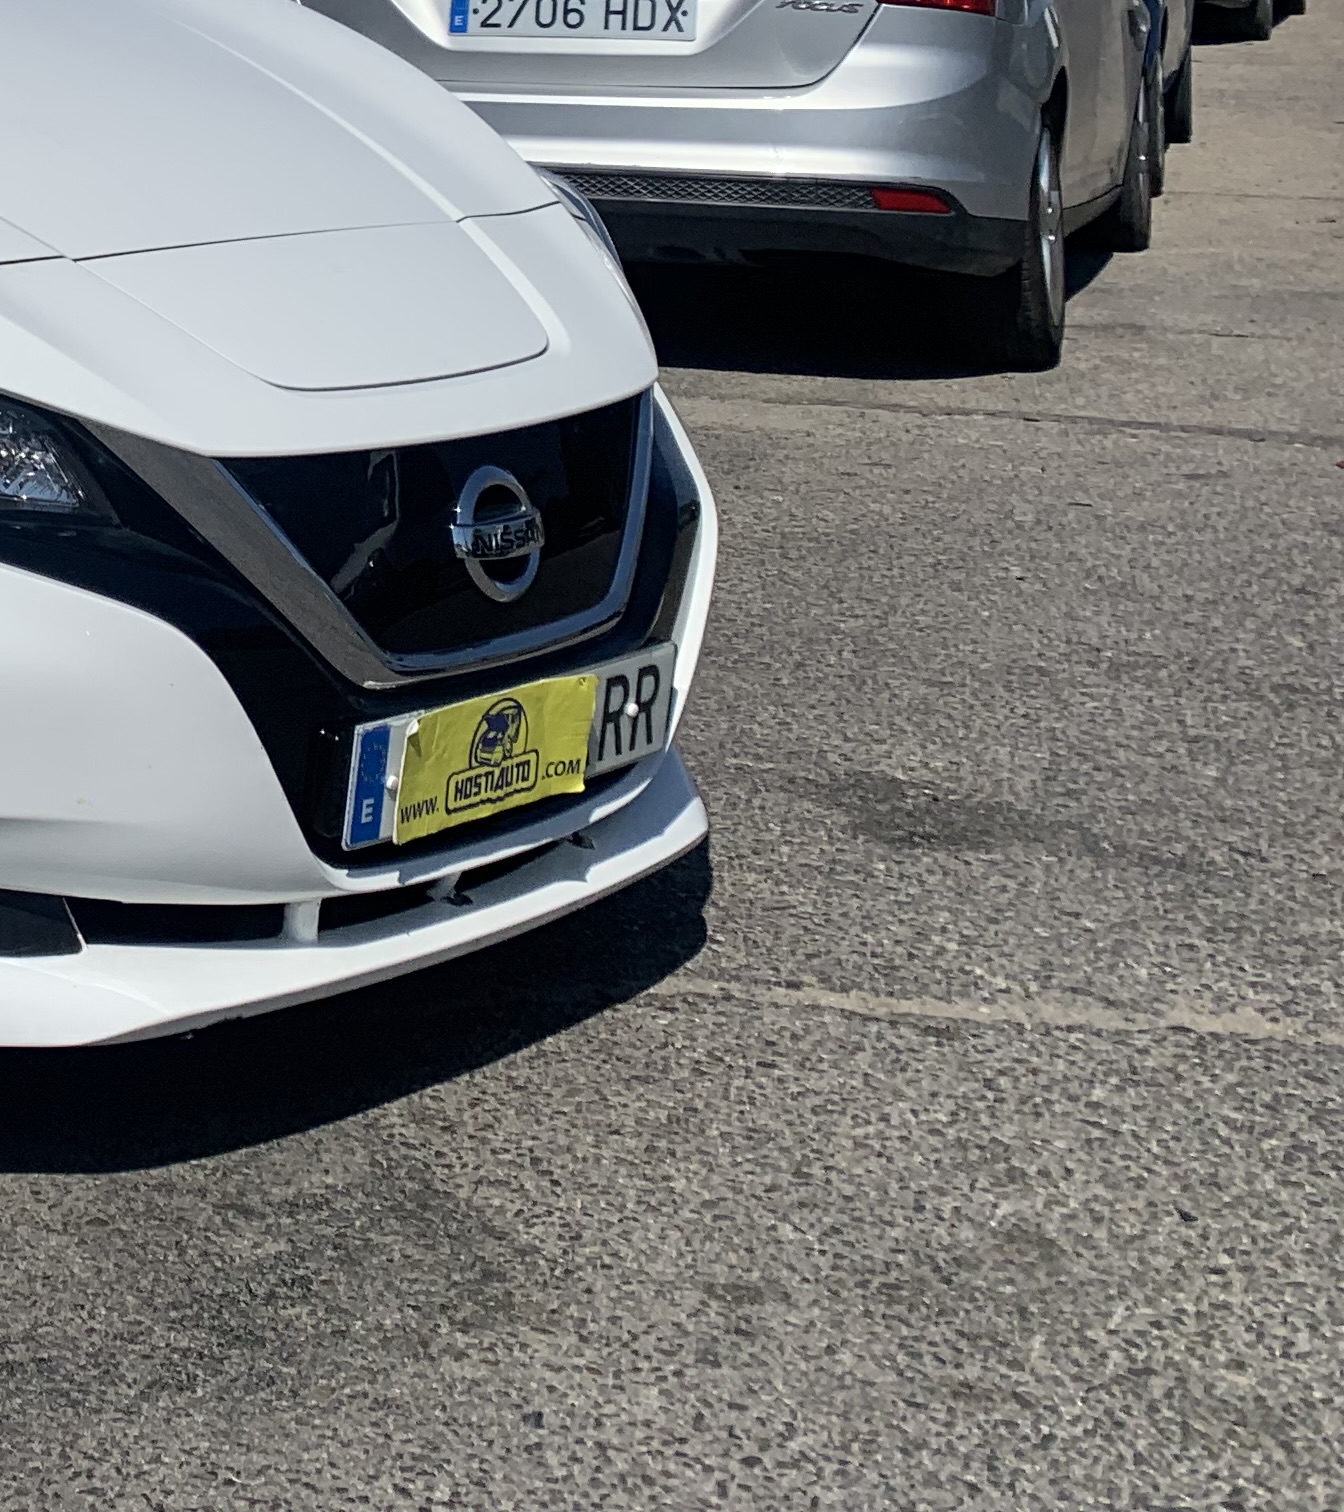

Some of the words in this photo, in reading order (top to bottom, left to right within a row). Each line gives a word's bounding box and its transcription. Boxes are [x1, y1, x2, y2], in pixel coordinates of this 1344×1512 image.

[454, 15, 463, 26] E
[454, 760, 530, 802] HOSTIAUTO
[542, 759, 580, 781] .COM
[360, 798, 374, 823] E
